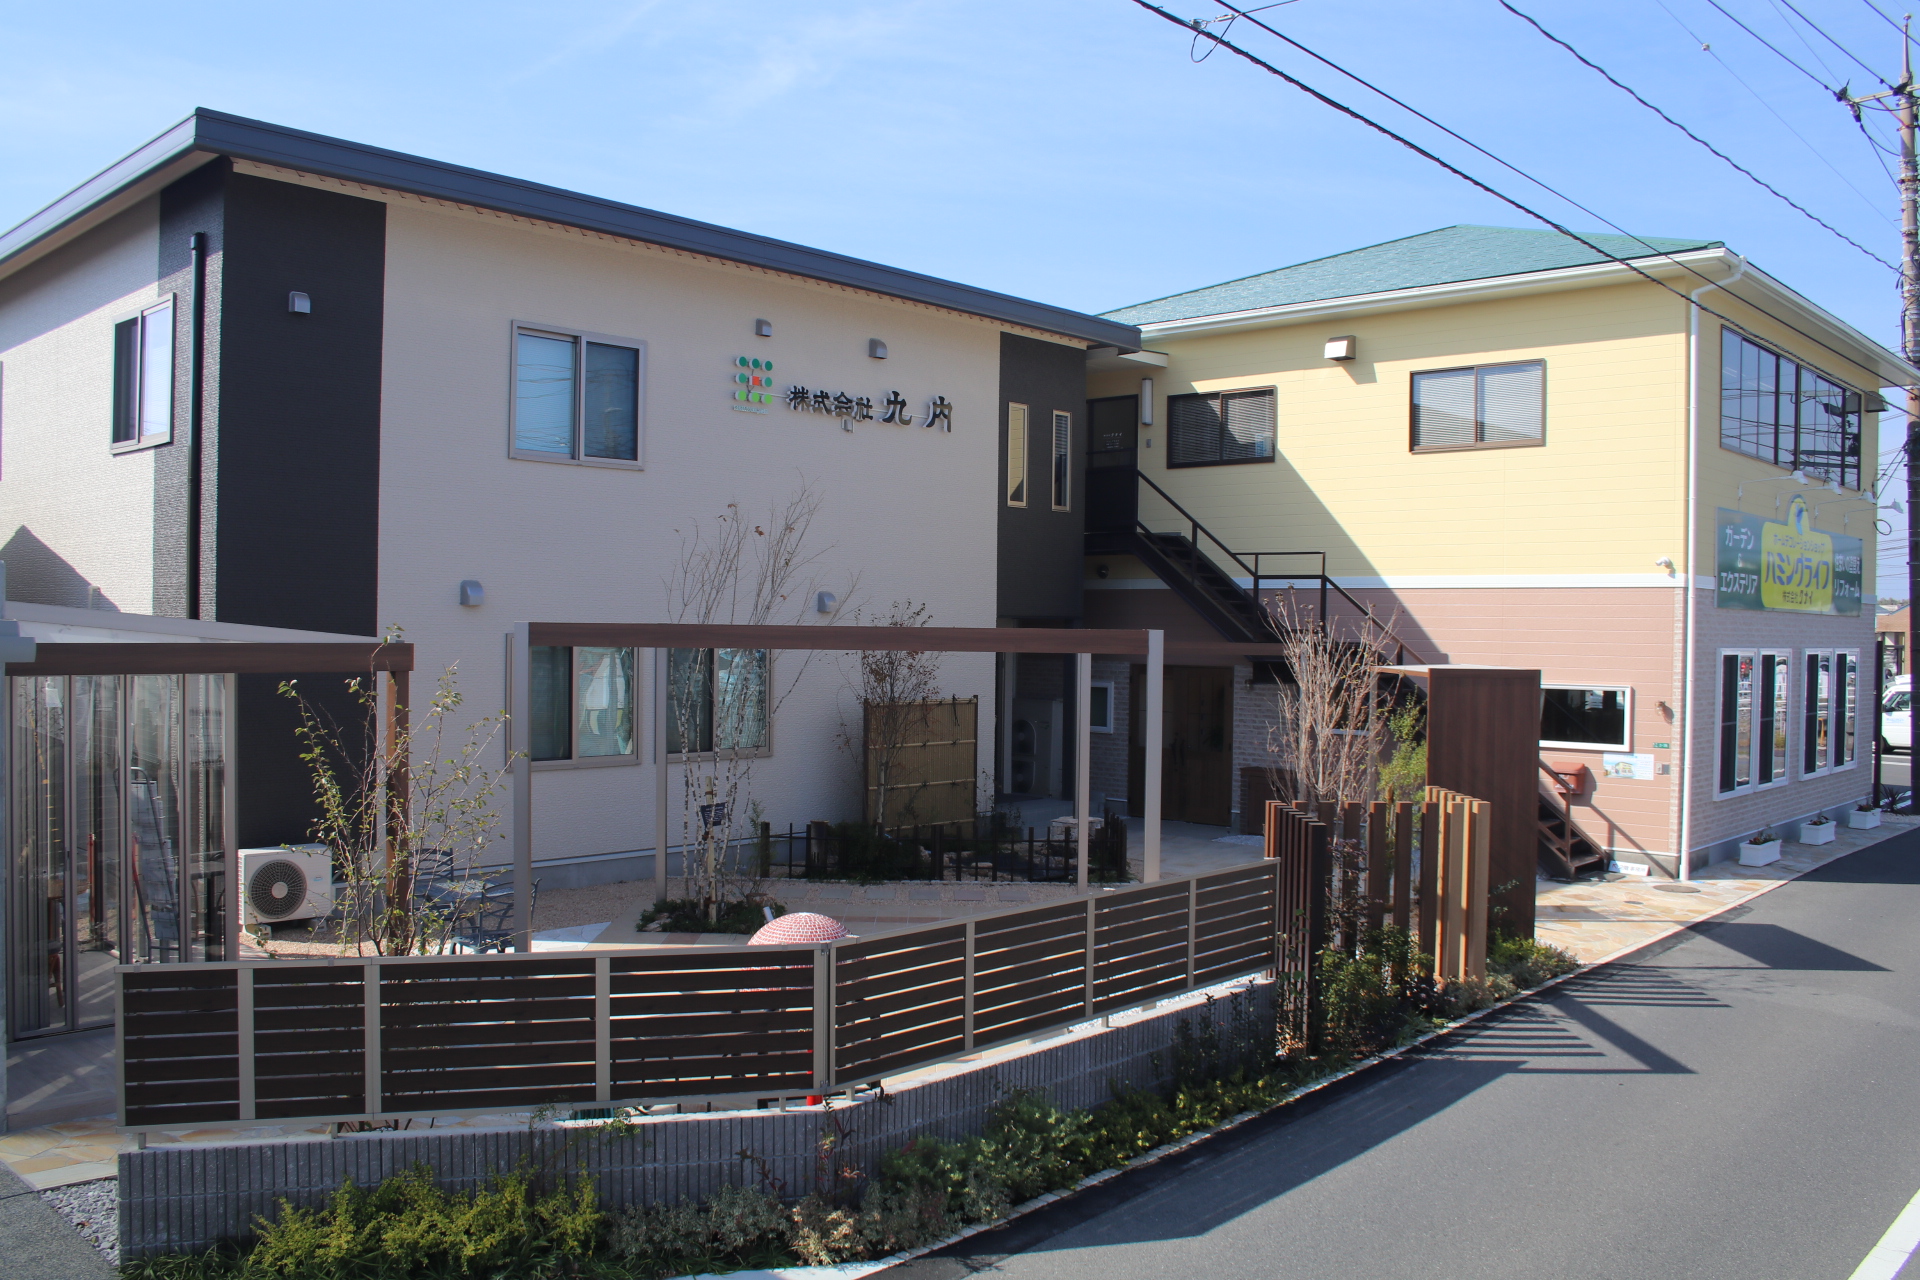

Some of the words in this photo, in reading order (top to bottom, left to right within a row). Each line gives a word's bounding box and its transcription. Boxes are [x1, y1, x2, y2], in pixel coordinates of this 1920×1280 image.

[1725, 525, 1754, 550] ガーデン
[1764, 551, 1830, 590] ハミングライフ
[1720, 571, 1758, 595] エクステリア
[1834, 578, 1861, 598] リフォーム
